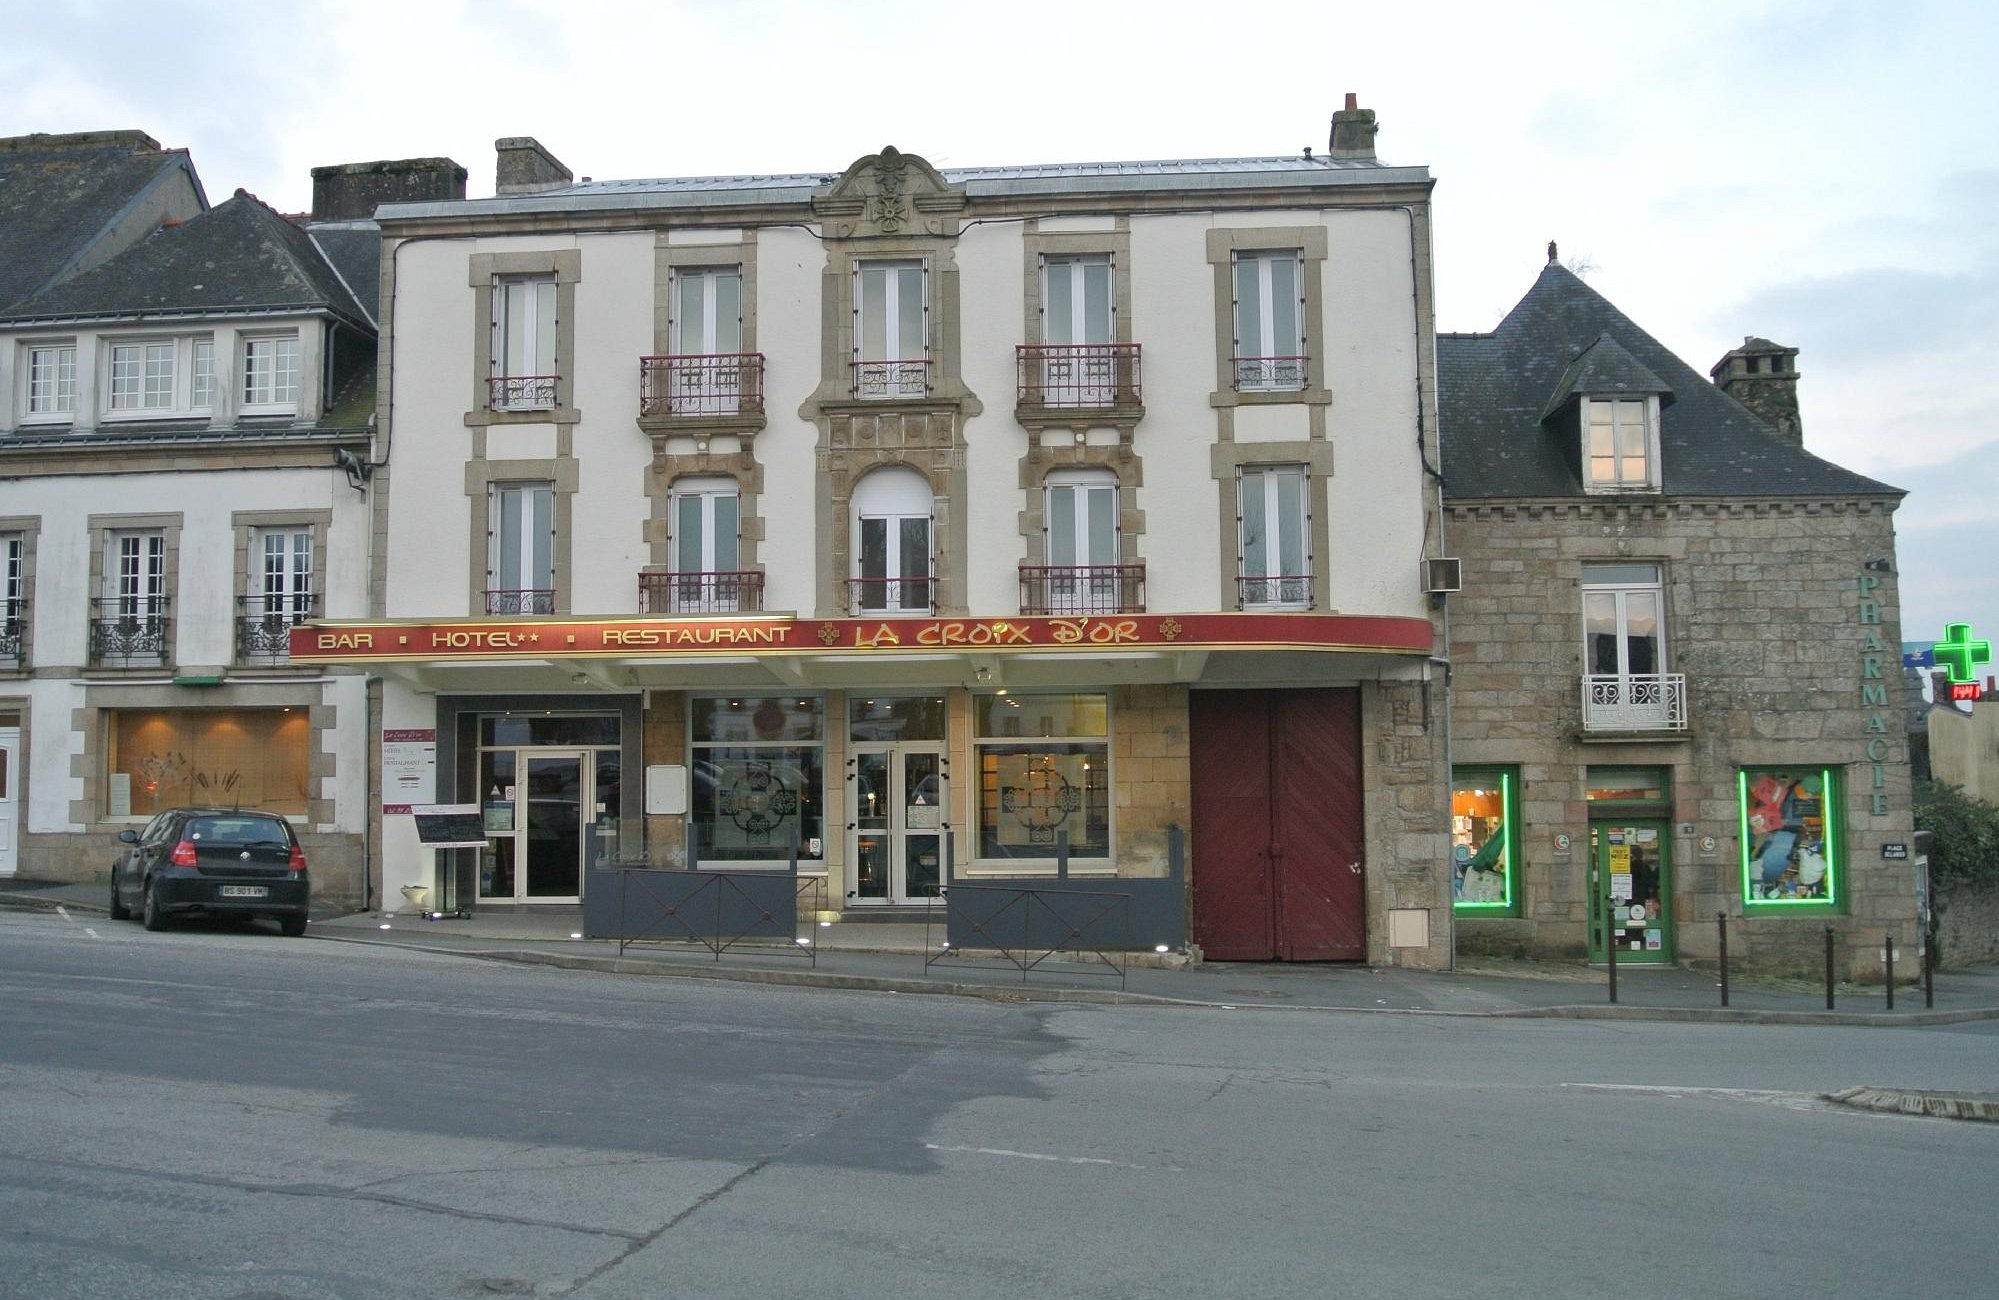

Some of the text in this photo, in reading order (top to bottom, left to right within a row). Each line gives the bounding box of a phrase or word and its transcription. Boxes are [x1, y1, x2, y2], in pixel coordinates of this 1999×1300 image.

[318, 626, 792, 649] BAR HOTEL RESTAURANT
[855, 617, 1140, 647] LA CROIX D'OR
[1857, 576, 1889, 817] PHARMACIE
